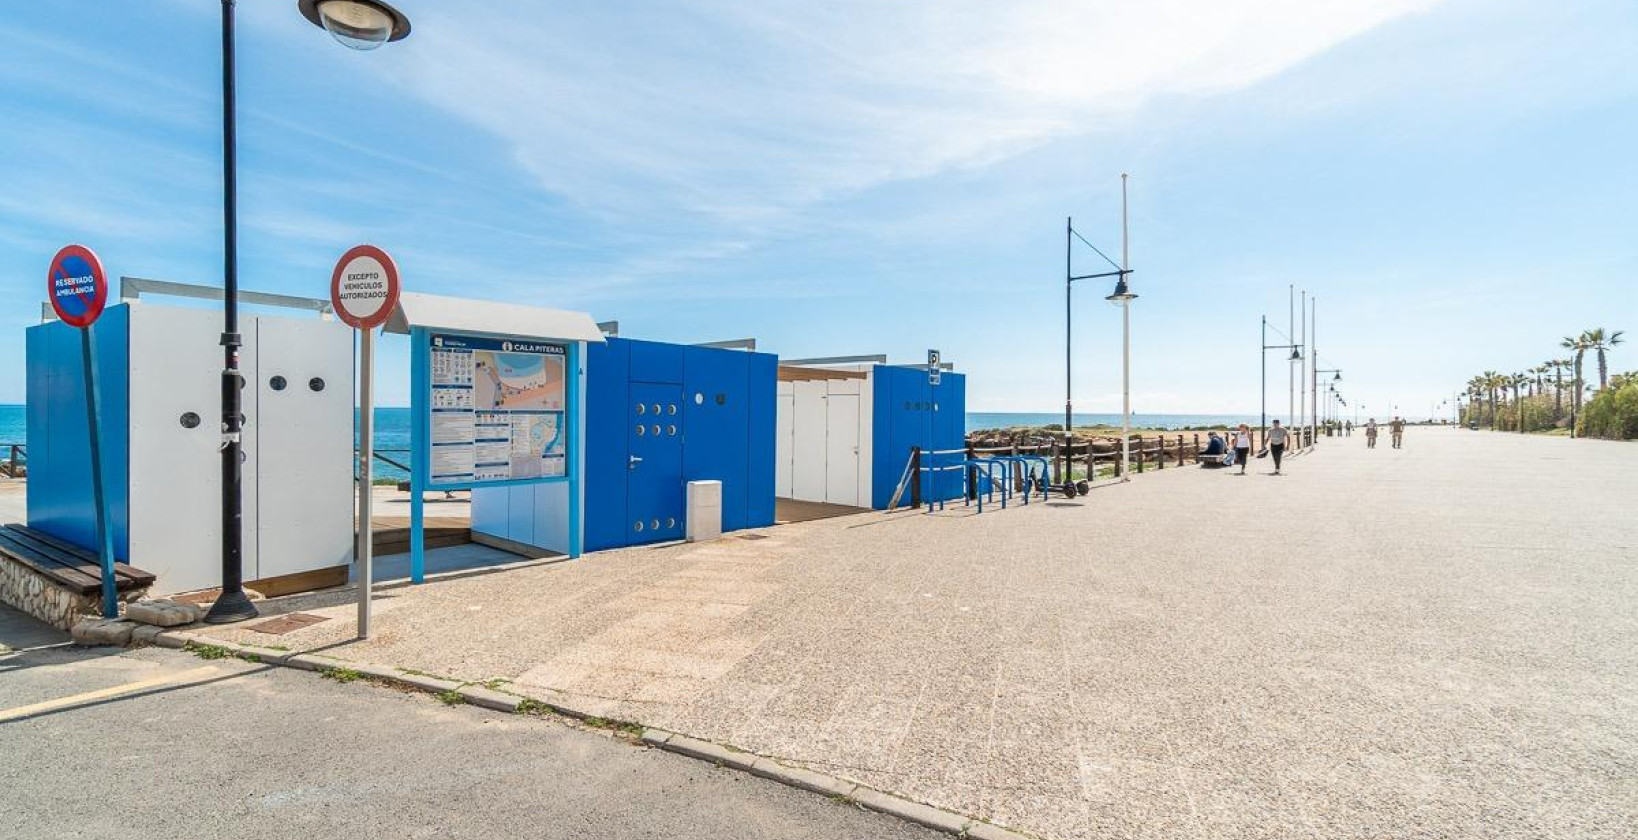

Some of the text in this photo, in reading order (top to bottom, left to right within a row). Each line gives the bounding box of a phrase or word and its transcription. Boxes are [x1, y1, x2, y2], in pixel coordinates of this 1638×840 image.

[55, 275, 94, 287] RESERVADO
[347, 272, 379, 281] EXCEPTO
[343, 281, 383, 290] VEHICULOS
[56, 286, 95, 297] AMBULANCIA
[340, 291, 389, 300] AUTORIZADOS
[514, 344, 534, 352] CALA
[535, 345, 565, 354] PITERAS
